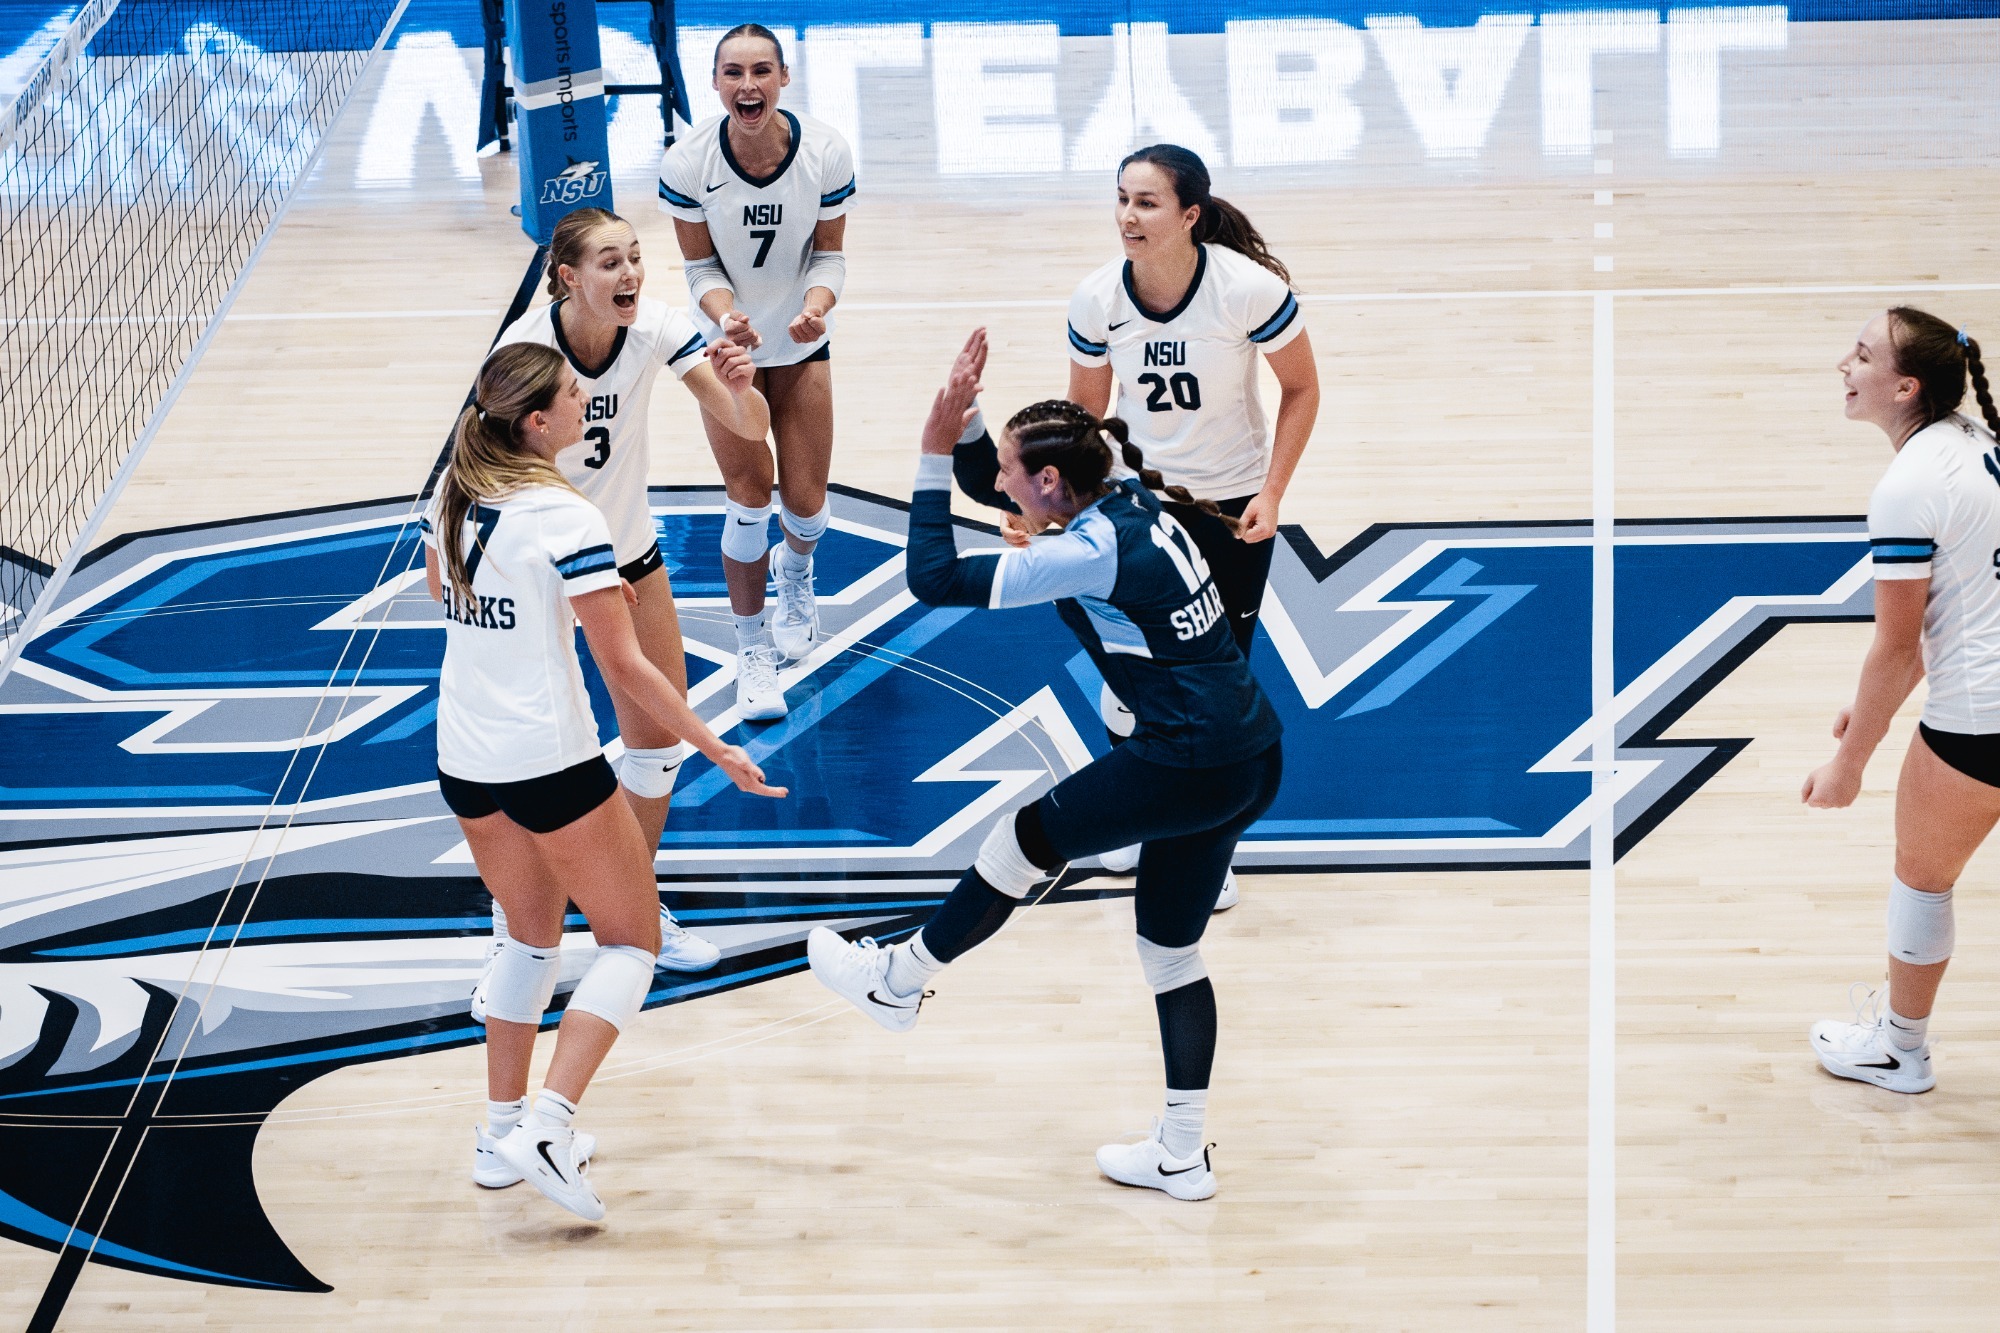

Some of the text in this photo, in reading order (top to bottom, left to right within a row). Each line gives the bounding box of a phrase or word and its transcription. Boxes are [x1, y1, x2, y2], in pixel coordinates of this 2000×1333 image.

[550, 1, 579, 142] sports imports
[539, 171, 607, 204] NSU
[743, 204, 783, 226] NSU
[750, 230, 776, 268] 7
[1144, 341, 1186, 366] NSU
[1137, 372, 1201, 412] 20
[584, 426, 611, 469] 3
[1149, 510, 1211, 595] 12
